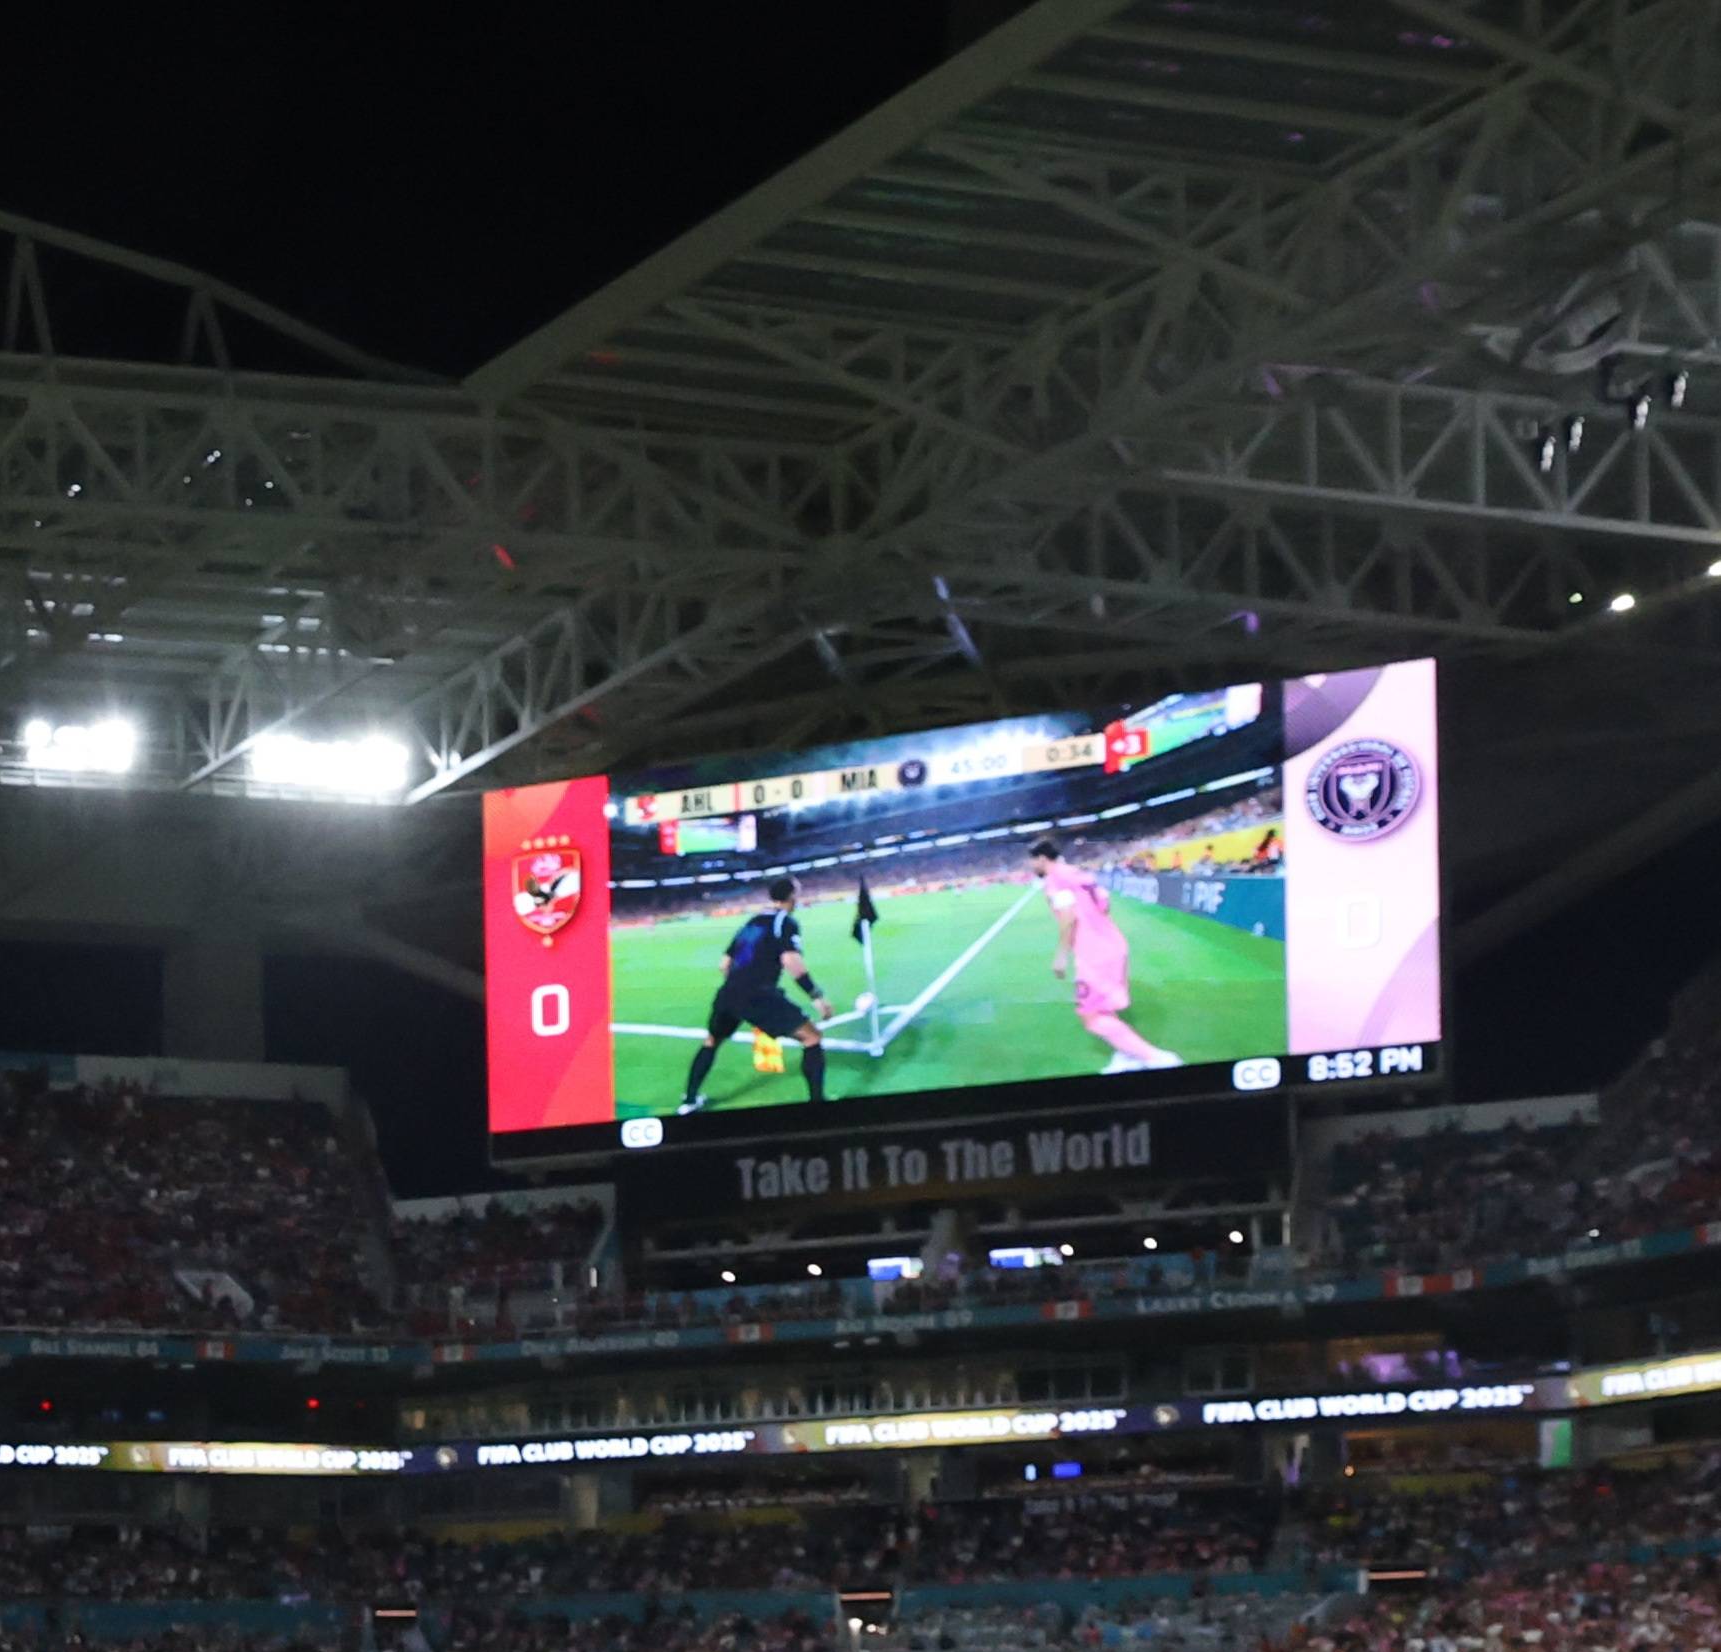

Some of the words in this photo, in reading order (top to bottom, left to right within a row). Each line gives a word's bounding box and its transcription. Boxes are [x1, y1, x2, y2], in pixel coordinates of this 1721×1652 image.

[531, 983, 570, 1037] 0
[1307, 1050, 1373, 1082] 8:52
[1379, 1044, 1423, 1075] PM
[1241, 1065, 1274, 1084] CC
[628, 1123, 657, 1143] CC
[736, 1155, 830, 1201] Take
[842, 1148, 869, 1190] It
[882, 1144, 927, 1185] To
[941, 1137, 1015, 1183] The
[1027, 1121, 1151, 1176] World
[1203, 1402, 1255, 1423] FIFA
[1256, 1398, 1318, 1419] CLUB
[1319, 1393, 1407, 1416] WORLD
[1408, 1390, 1459, 1411] CUP
[1012, 1413, 1059, 1435] CUP
[16, 1446, 54, 1464] CUP
[650, 1435, 692, 1454] CUP
